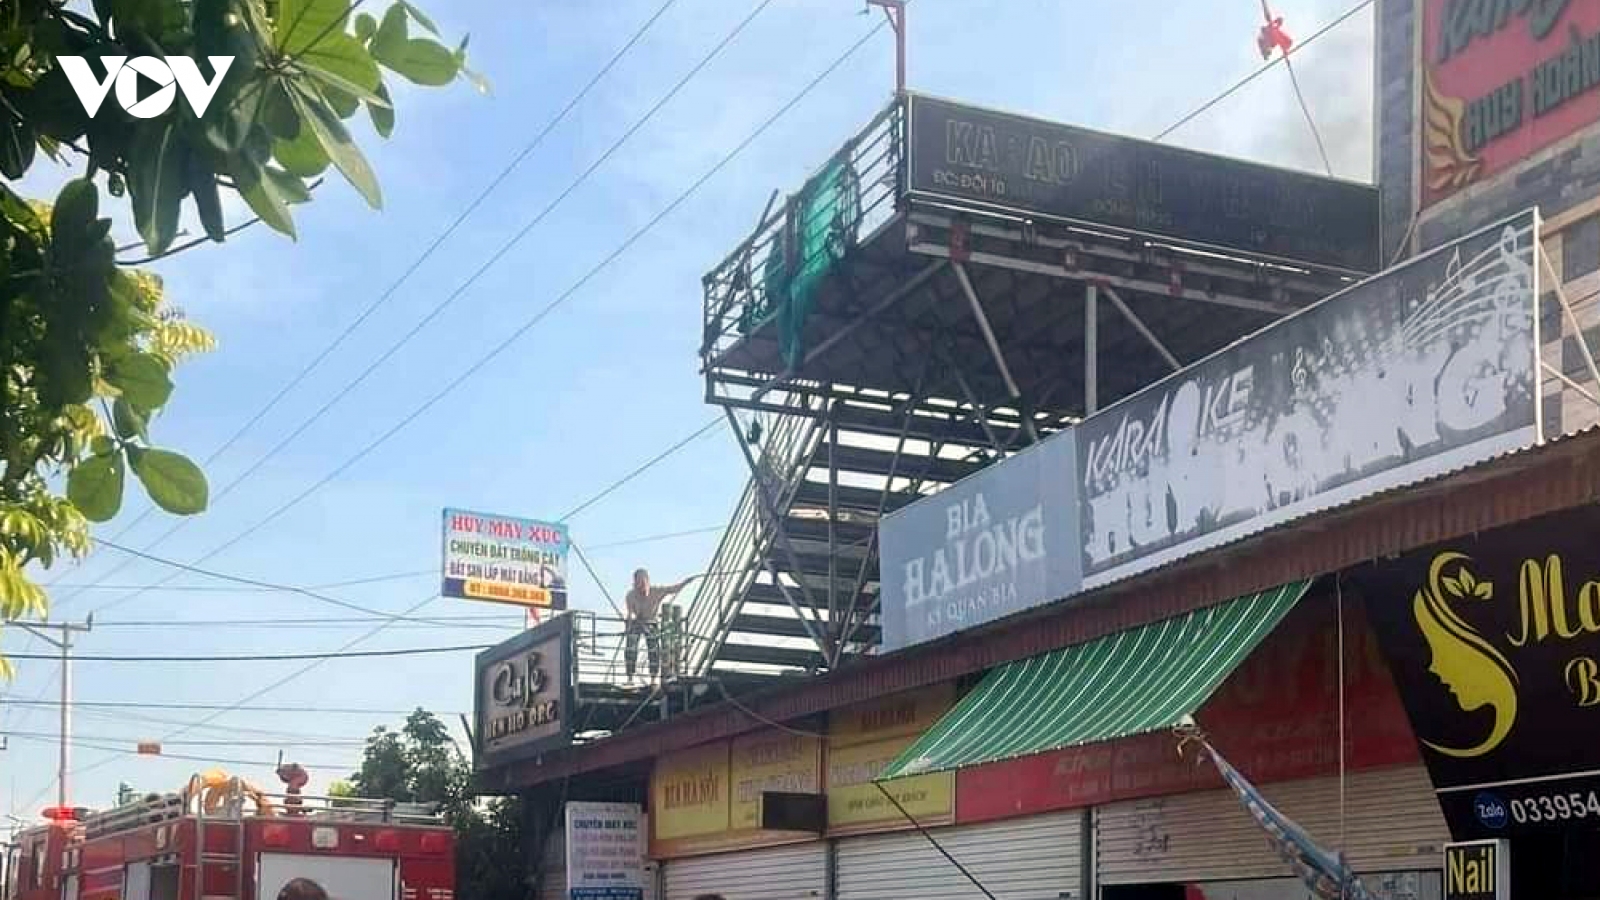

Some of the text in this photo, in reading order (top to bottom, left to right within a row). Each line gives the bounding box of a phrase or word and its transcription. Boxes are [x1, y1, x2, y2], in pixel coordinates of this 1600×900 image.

[946, 492, 991, 540] BIA
[1511, 791, 1600, 823] 033954
[1448, 846, 1494, 896] Nail
